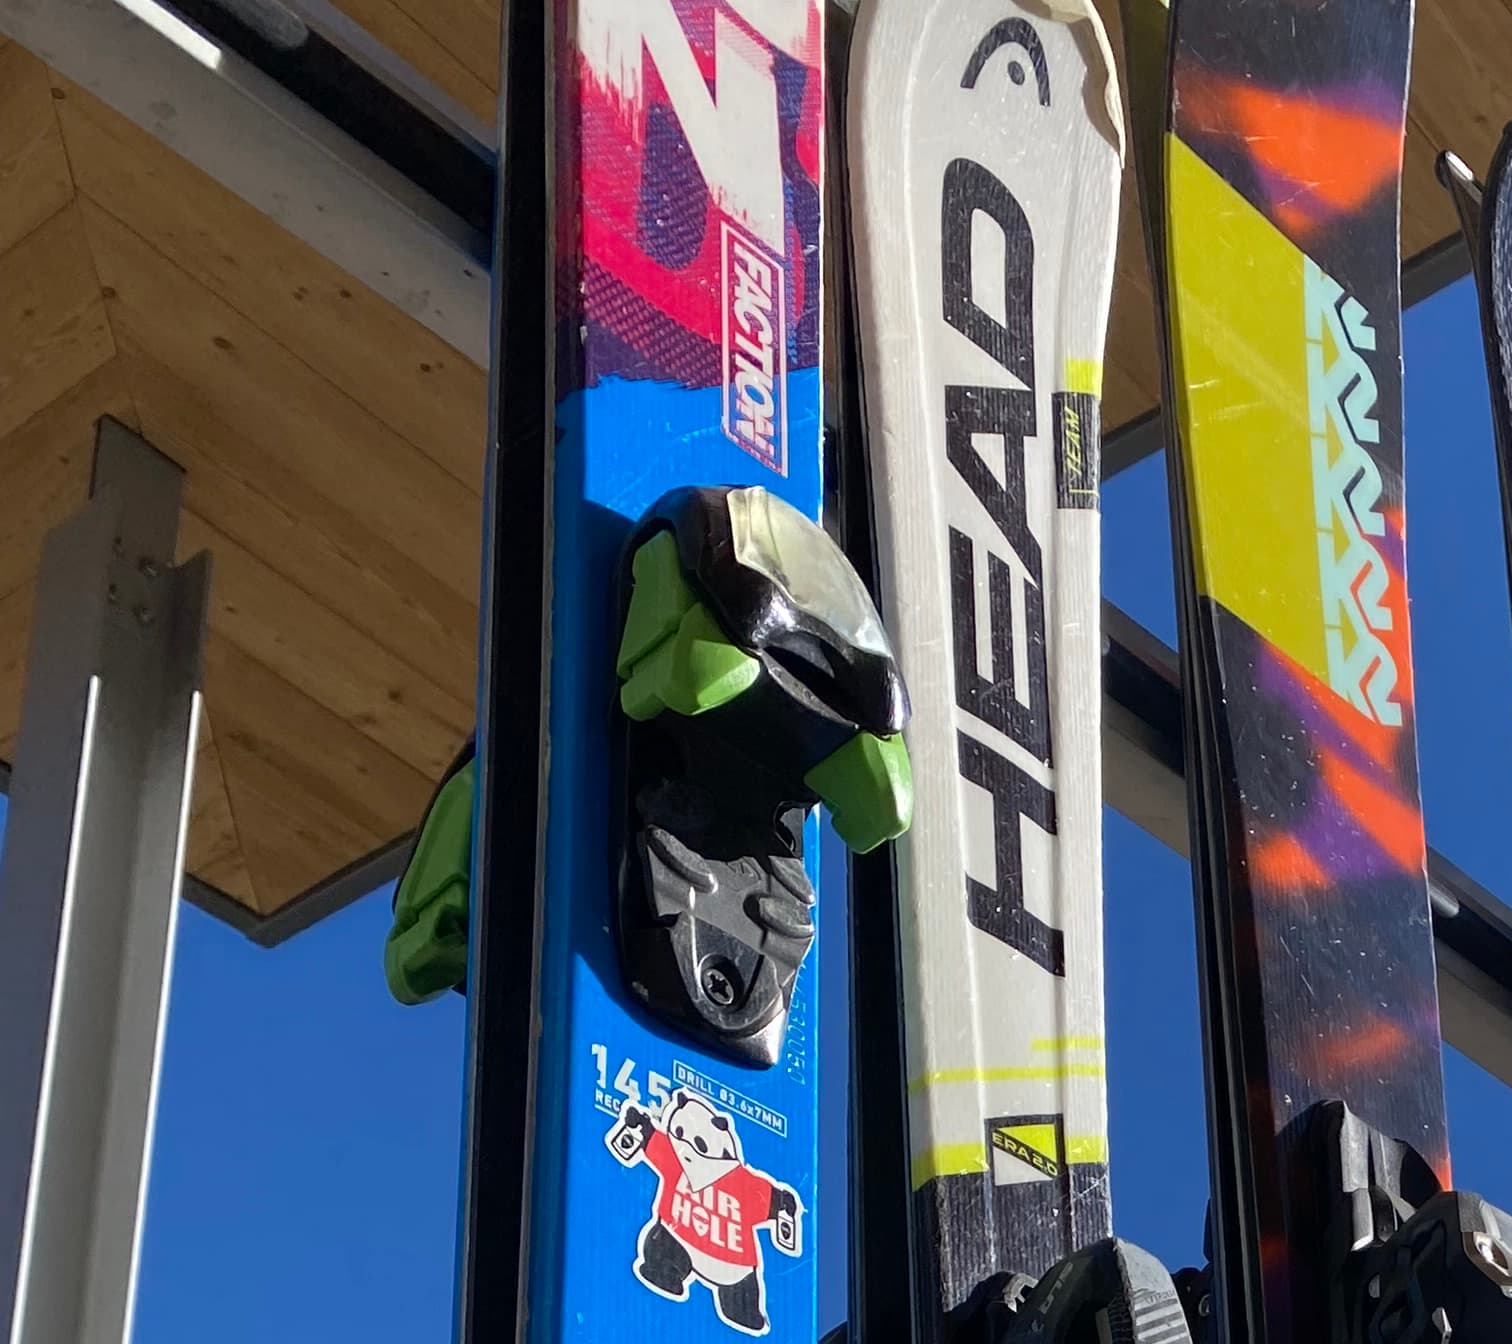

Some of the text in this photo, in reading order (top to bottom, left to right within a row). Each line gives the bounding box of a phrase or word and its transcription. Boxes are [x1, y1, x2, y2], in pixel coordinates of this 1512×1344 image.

[734, 241, 776, 459] FACTION
[942, 158, 1065, 977] HEAD
[591, 1044, 671, 1123] 145
[678, 1067, 715, 1096] DRILL
[992, 1132, 1058, 1177] ERA 2.0
[675, 1172, 742, 1222] AIR
